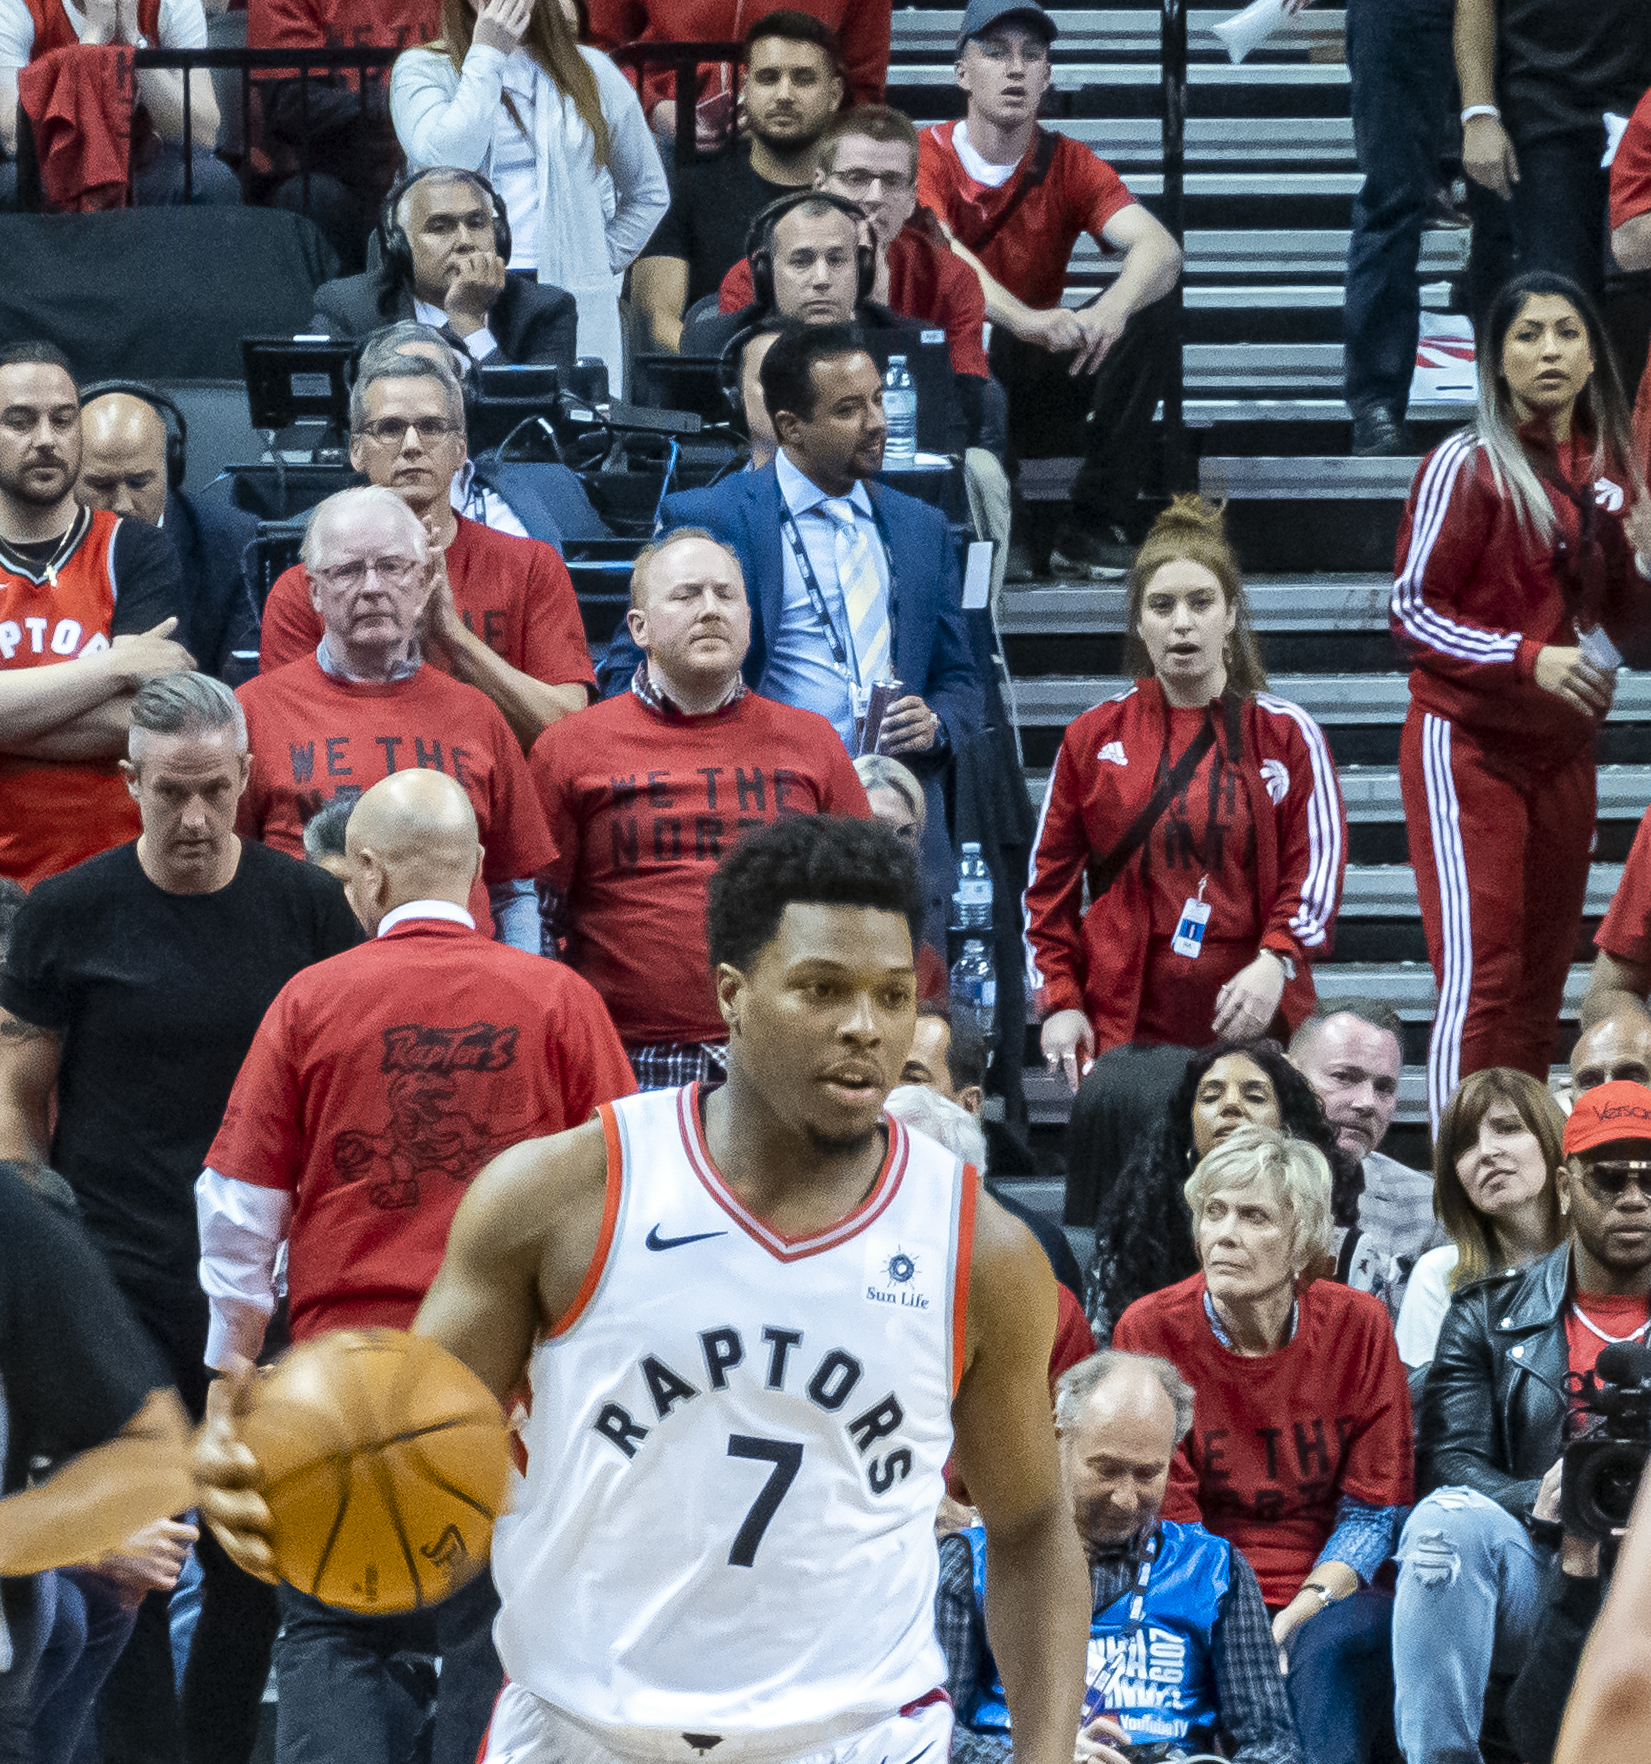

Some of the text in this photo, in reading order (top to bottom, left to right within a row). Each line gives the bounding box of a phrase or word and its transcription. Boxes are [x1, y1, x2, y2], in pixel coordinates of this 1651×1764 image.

[289, 737, 352, 783] WE
[610, 770, 674, 811] WE
[866, 1286, 930, 1310] Sun Life
[591, 1324, 913, 1498] RAPTORS
[724, 1433, 805, 1568] 7
